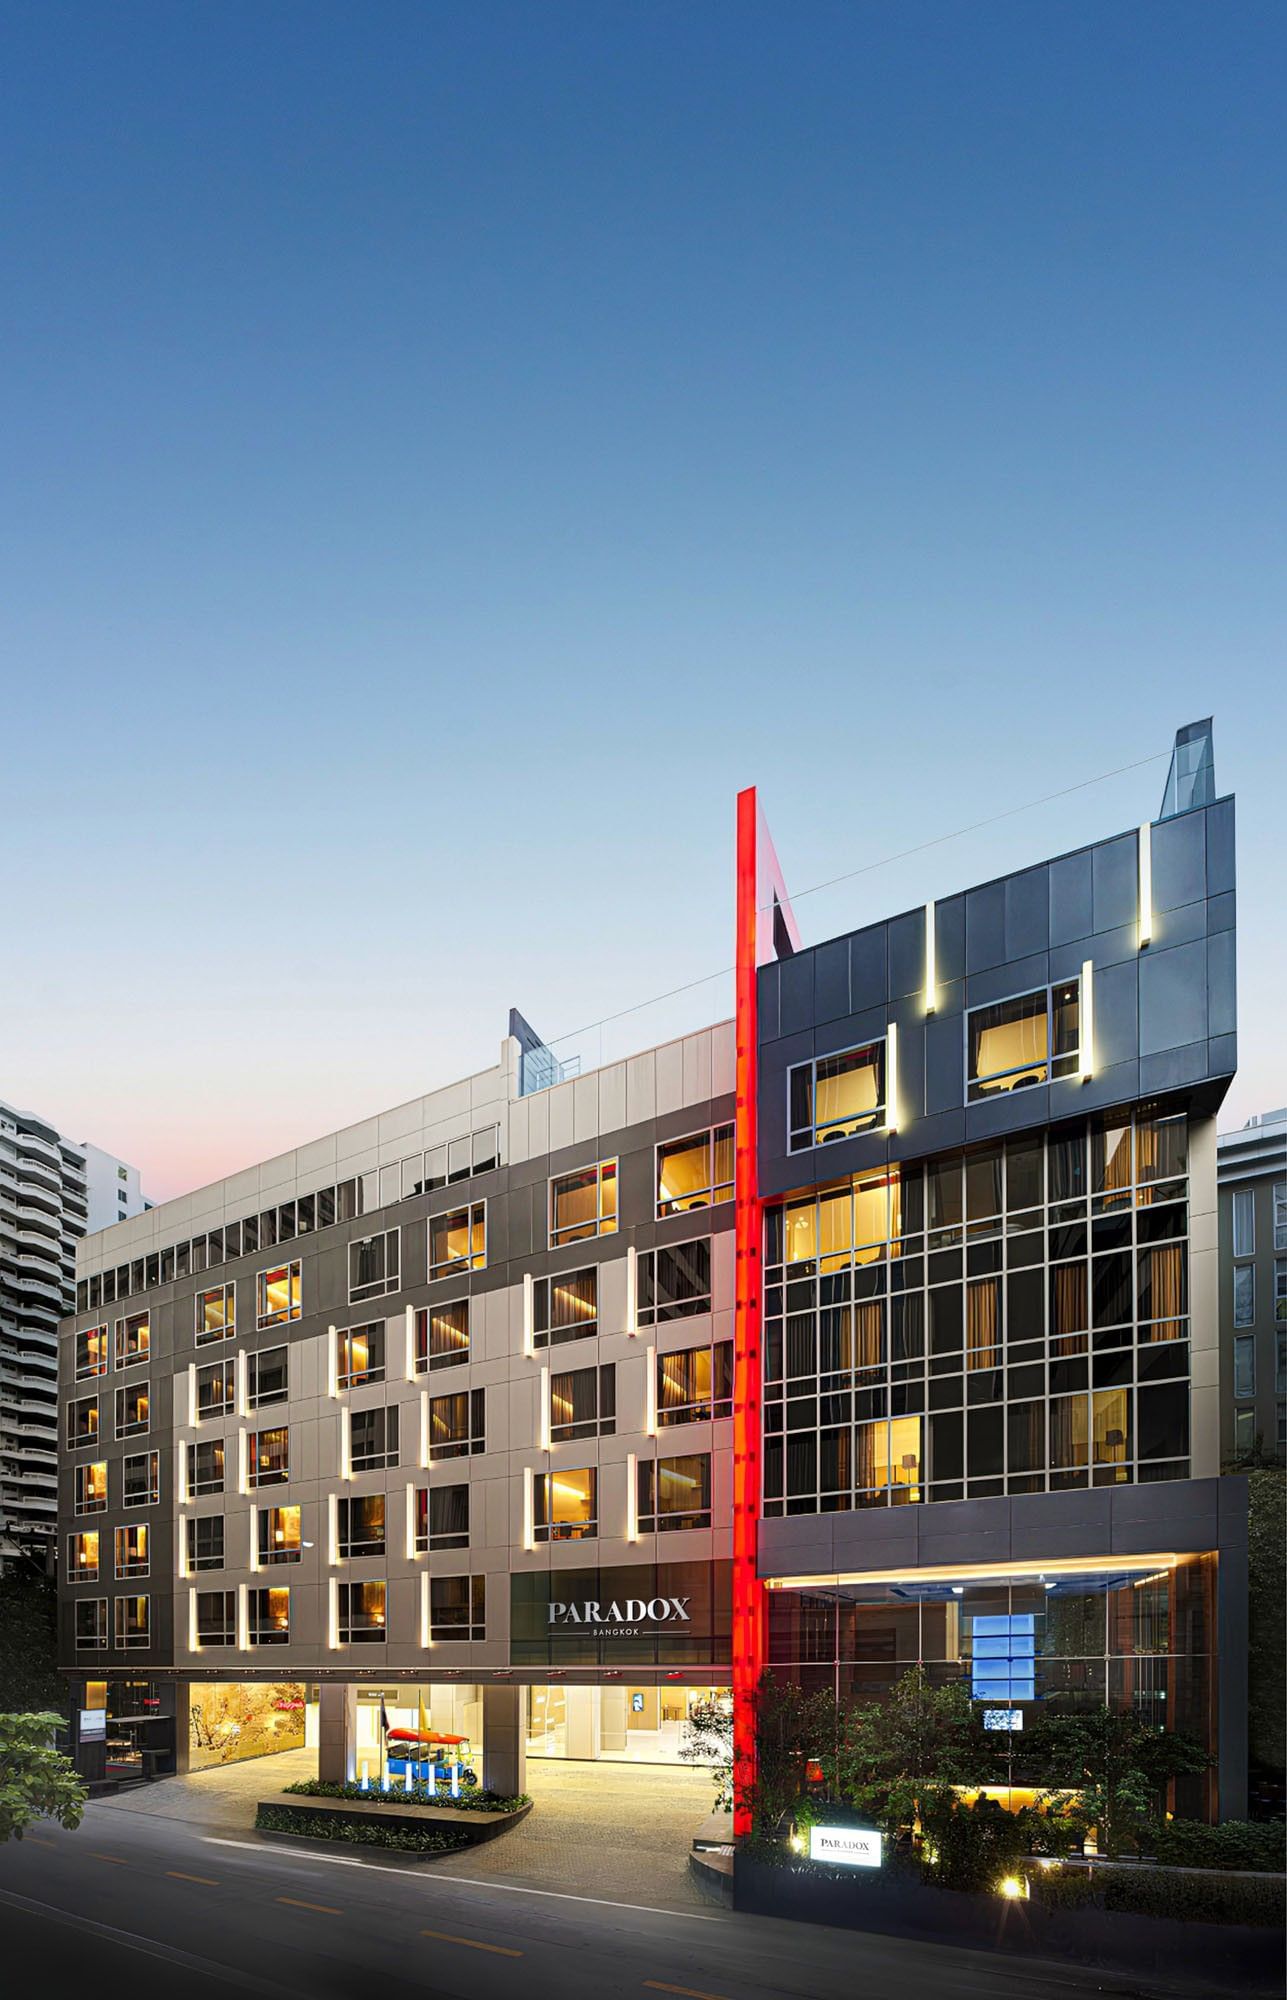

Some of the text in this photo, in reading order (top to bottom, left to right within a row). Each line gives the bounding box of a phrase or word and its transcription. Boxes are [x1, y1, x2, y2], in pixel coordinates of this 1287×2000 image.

[547, 1597, 691, 1624] PARADOX
[593, 1628, 640, 1637] BANGKOK
[820, 1838, 870, 1851] PARADOX
